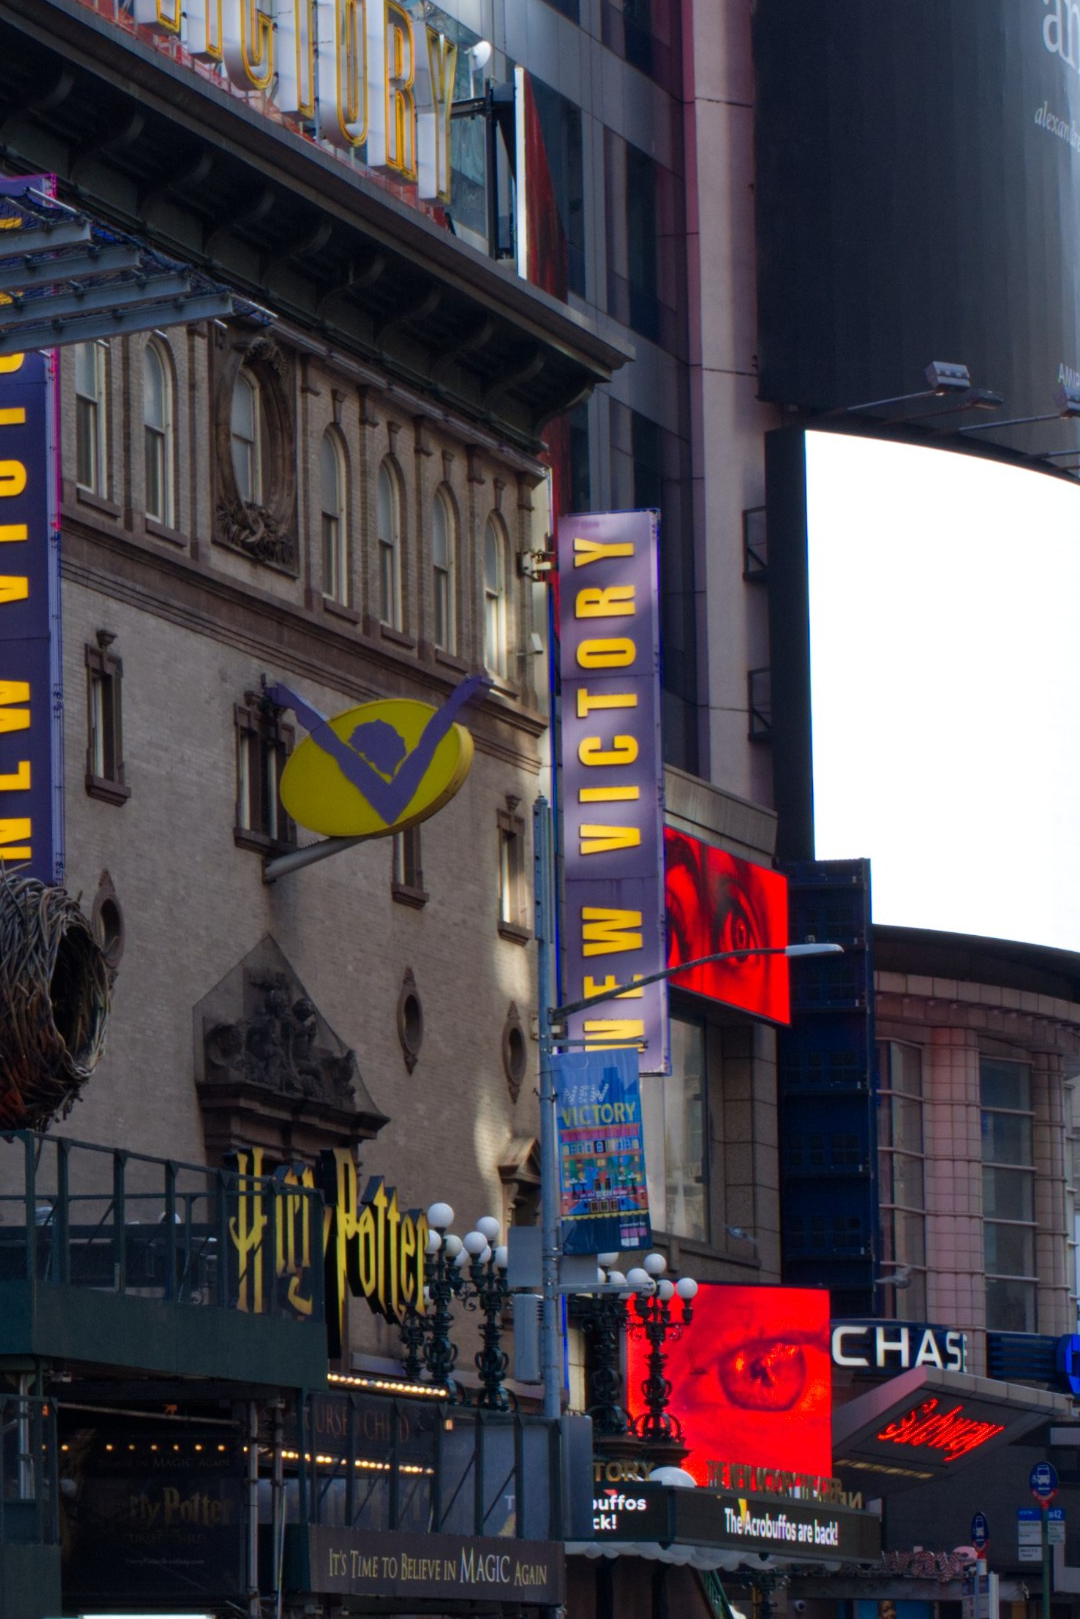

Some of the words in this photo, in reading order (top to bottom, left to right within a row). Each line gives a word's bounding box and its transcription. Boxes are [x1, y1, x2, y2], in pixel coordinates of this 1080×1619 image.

[573, 538, 641, 855] VICTORY
[581, 907, 644, 1053] NEW
[562, 1102, 636, 1127] VICTORY
[332, 1148, 429, 1345] Potter
[877, 1398, 1004, 1463] Subway
[724, 1507, 743, 1535] The
[744, 1510, 797, 1541] Acrobuffos
[798, 1522, 813, 1544] are
[814, 1519, 839, 1546] back!
[460, 1547, 511, 1584] MAGIC
